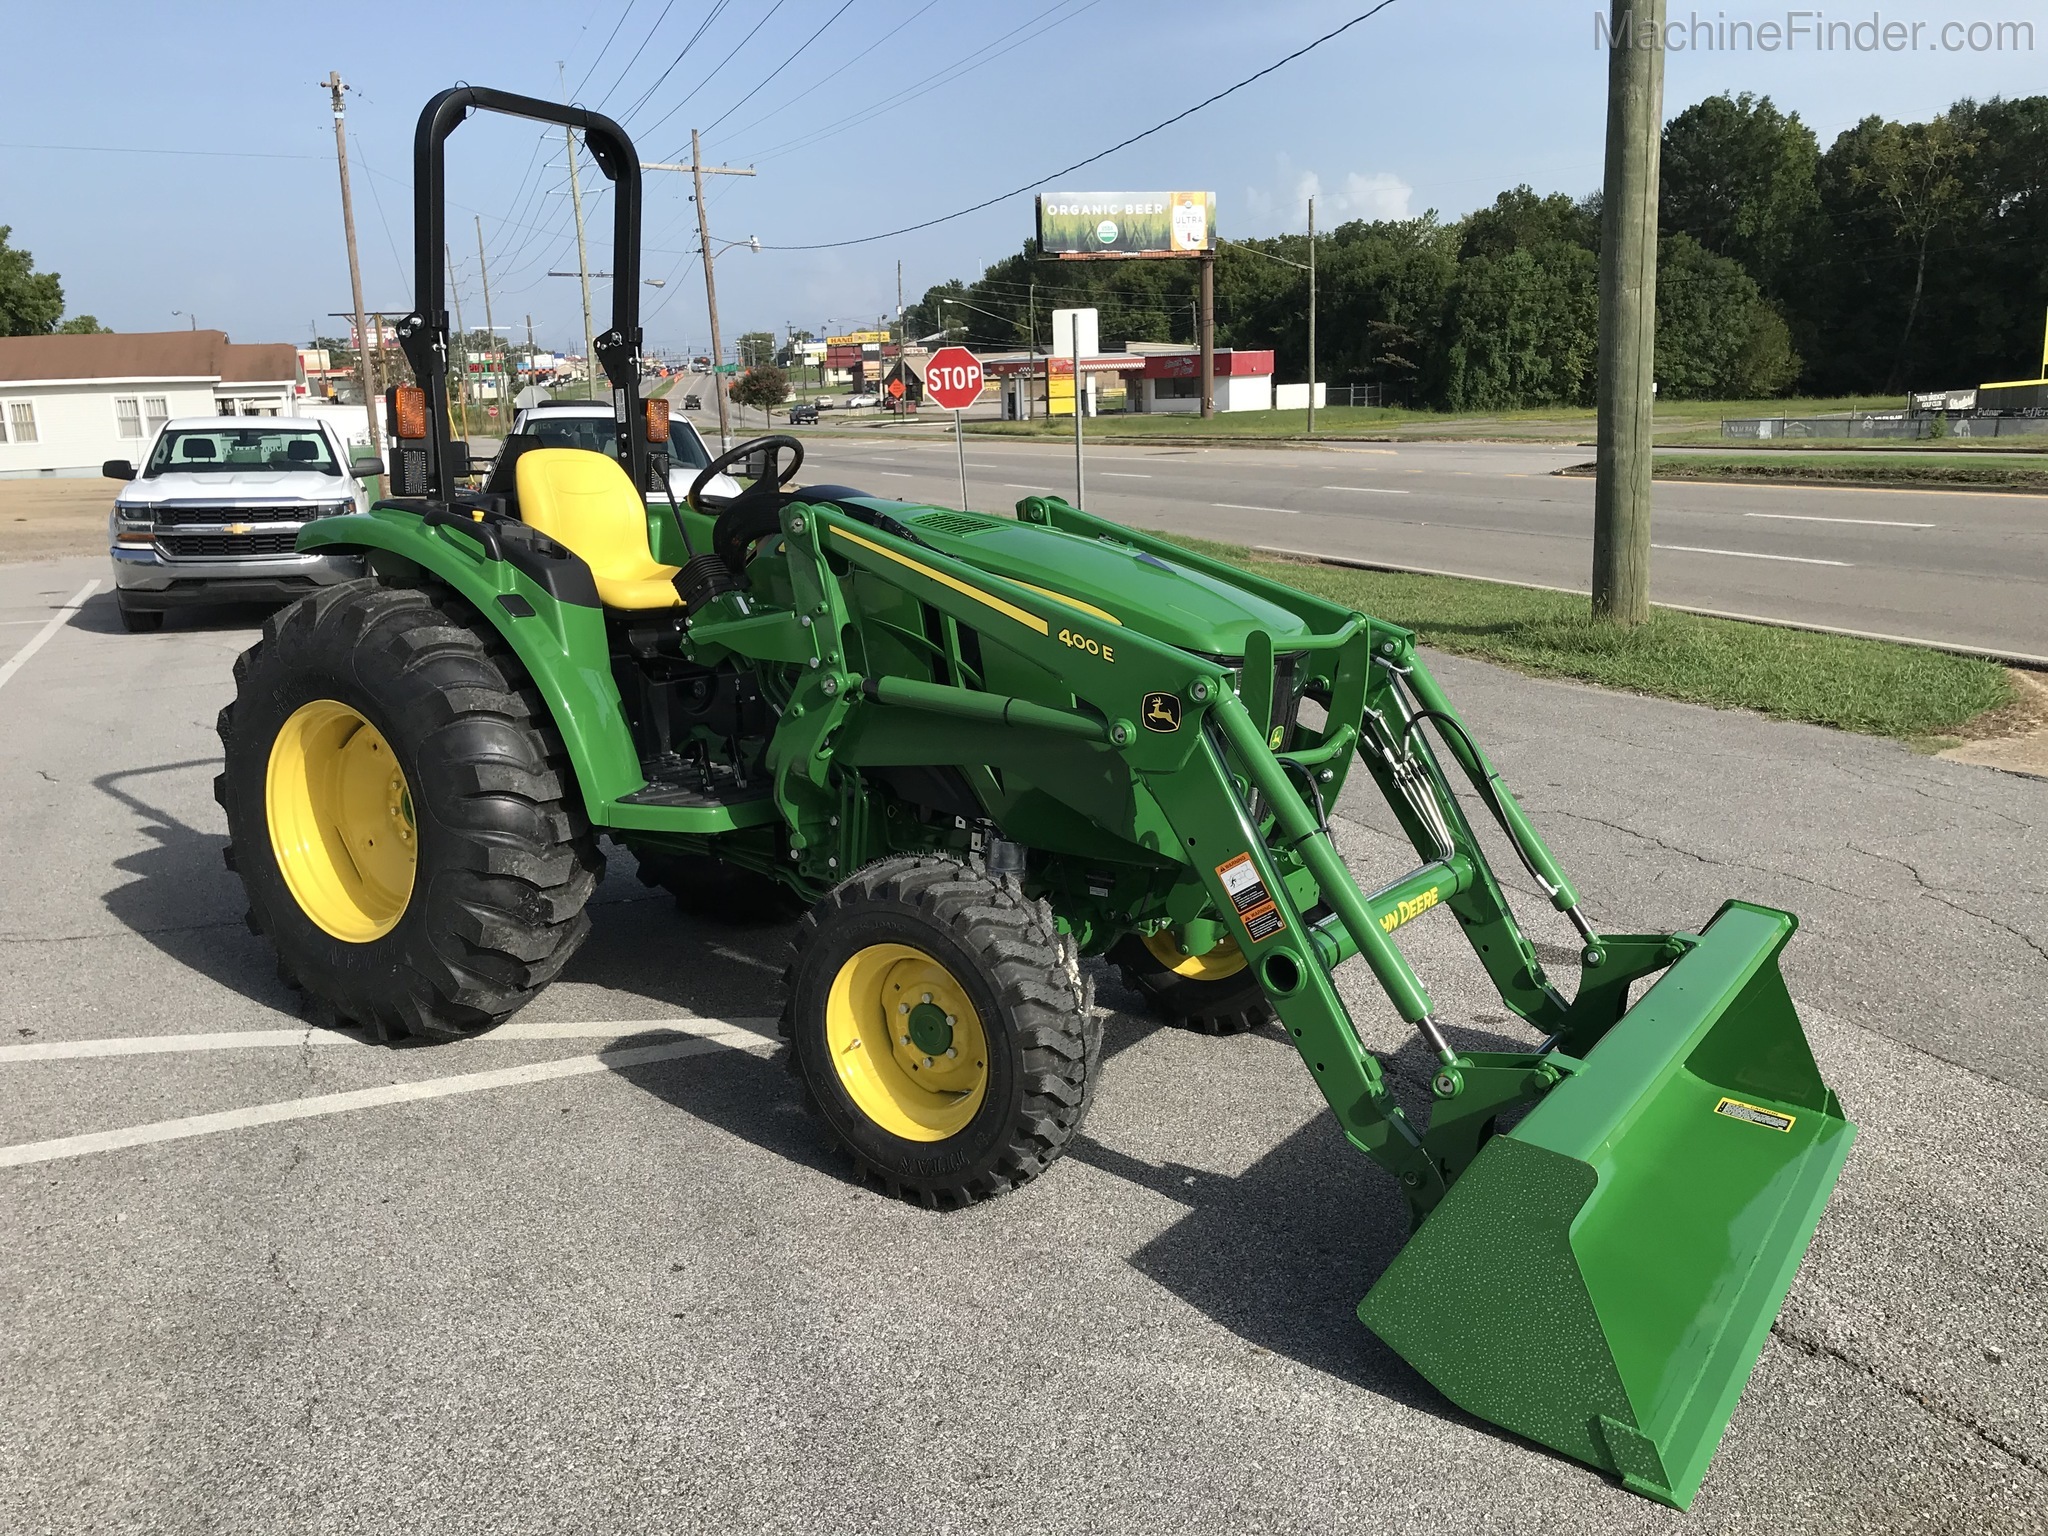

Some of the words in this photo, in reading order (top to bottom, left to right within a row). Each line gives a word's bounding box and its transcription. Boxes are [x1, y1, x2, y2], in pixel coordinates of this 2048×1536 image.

[1047, 204, 1118, 216] ORGANIC
[1125, 203, 1163, 215] BEER
[1175, 216, 1204, 224] ULTRA
[928, 366, 980, 392] STOP
[1058, 628, 1099, 656] 400
[1101, 644, 1115, 663] E
[1378, 909, 1399, 933] HN
[1397, 886, 1439, 925] DEERE
[898, 1147, 971, 1176] TITAN
